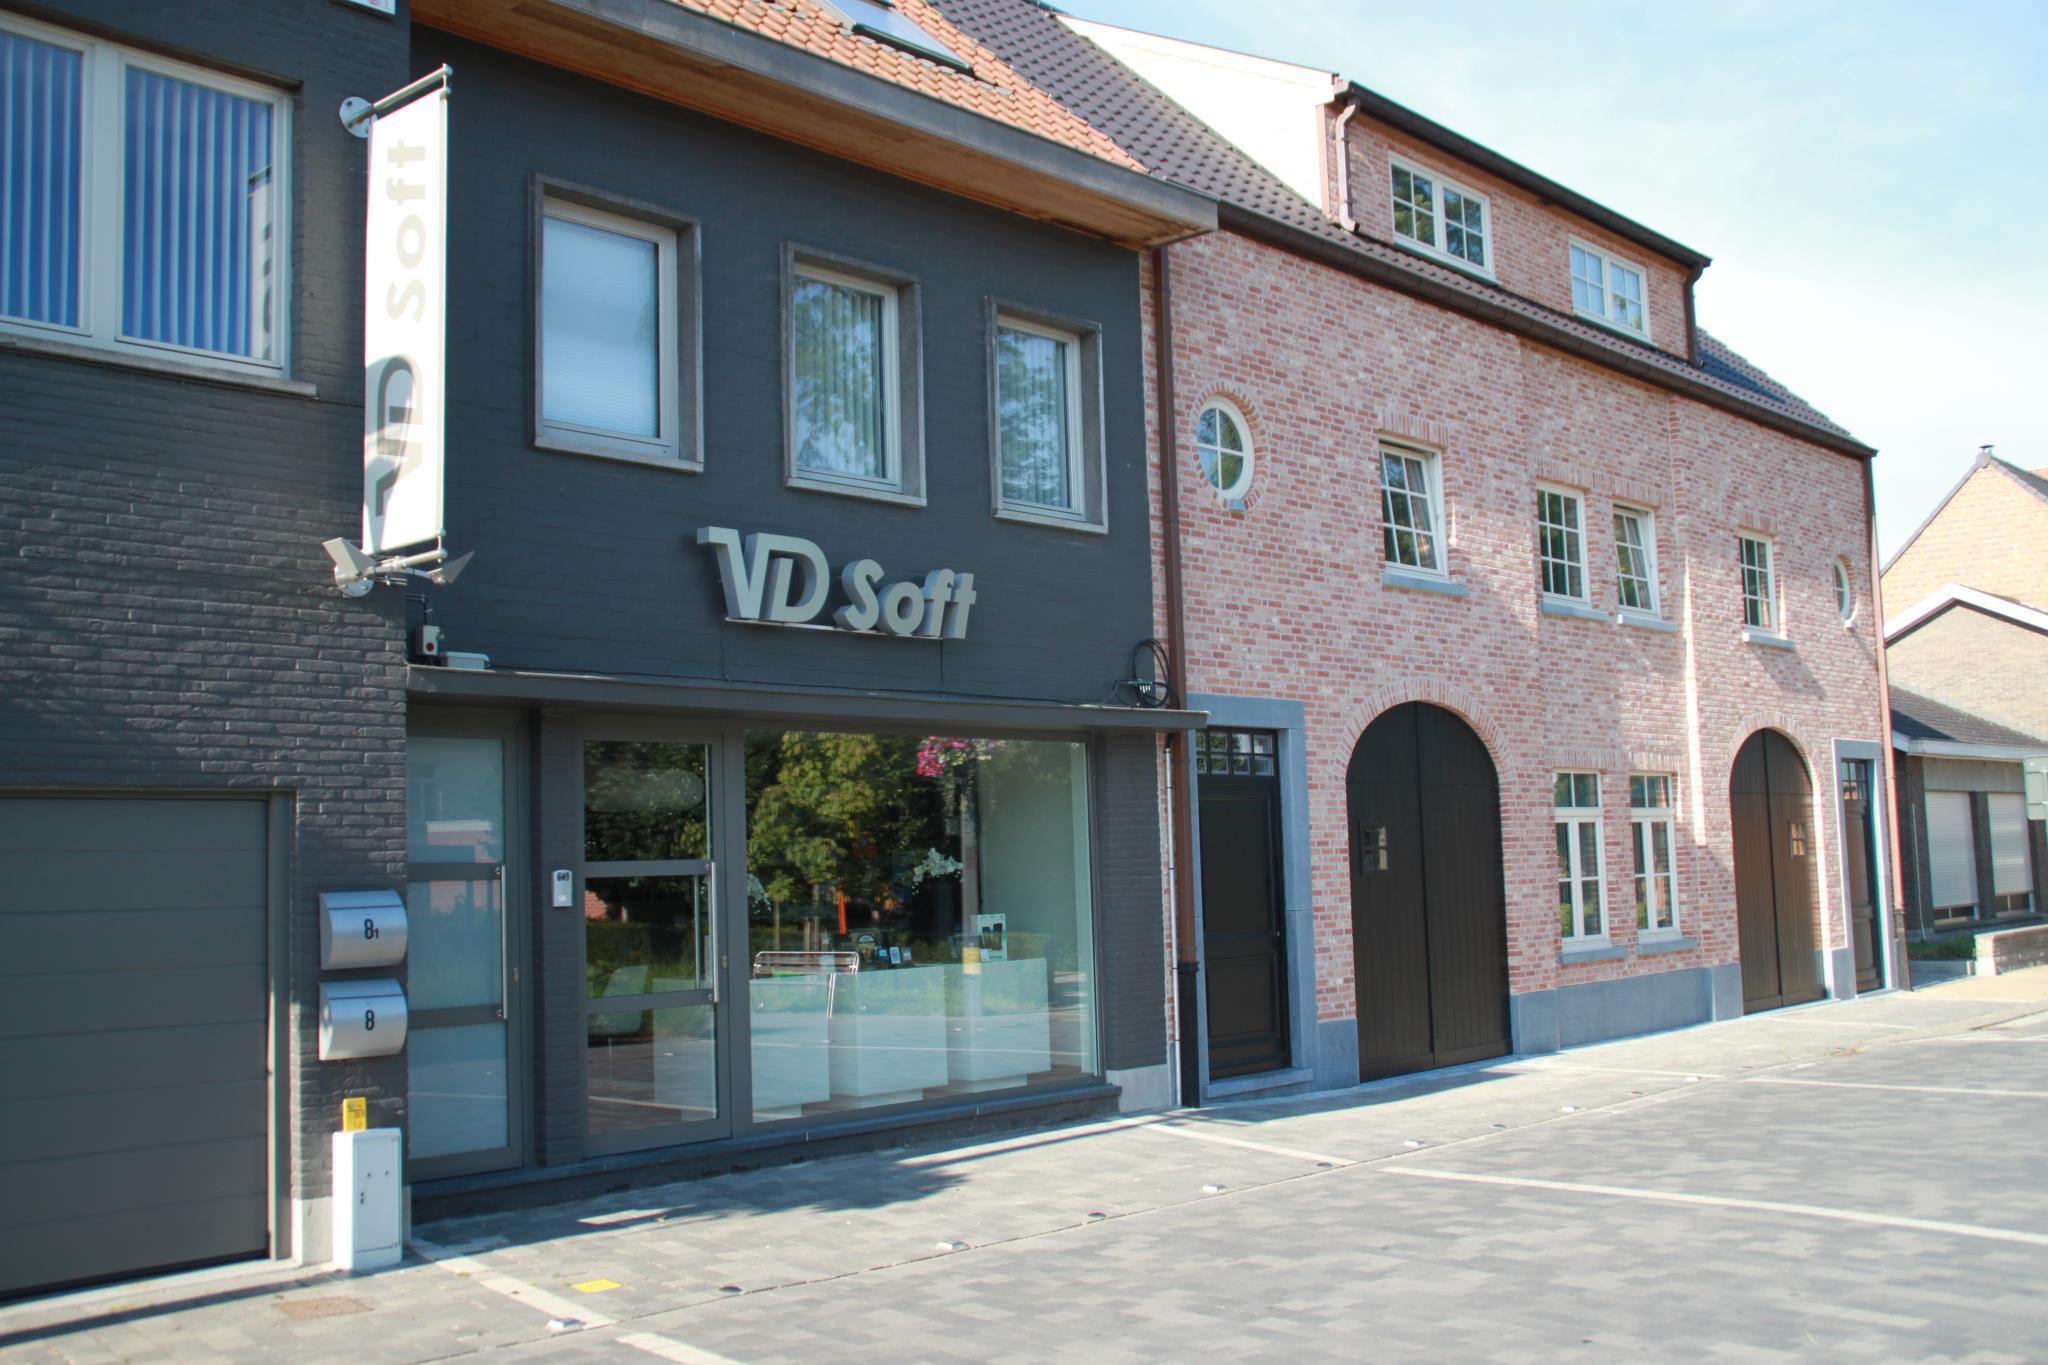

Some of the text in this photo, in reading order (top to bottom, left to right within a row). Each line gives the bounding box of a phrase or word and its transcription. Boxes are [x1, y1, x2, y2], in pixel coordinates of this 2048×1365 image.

[375, 354, 424, 517] VD
[697, 525, 977, 639] VD Soft
[365, 1010, 375, 1031] 8
